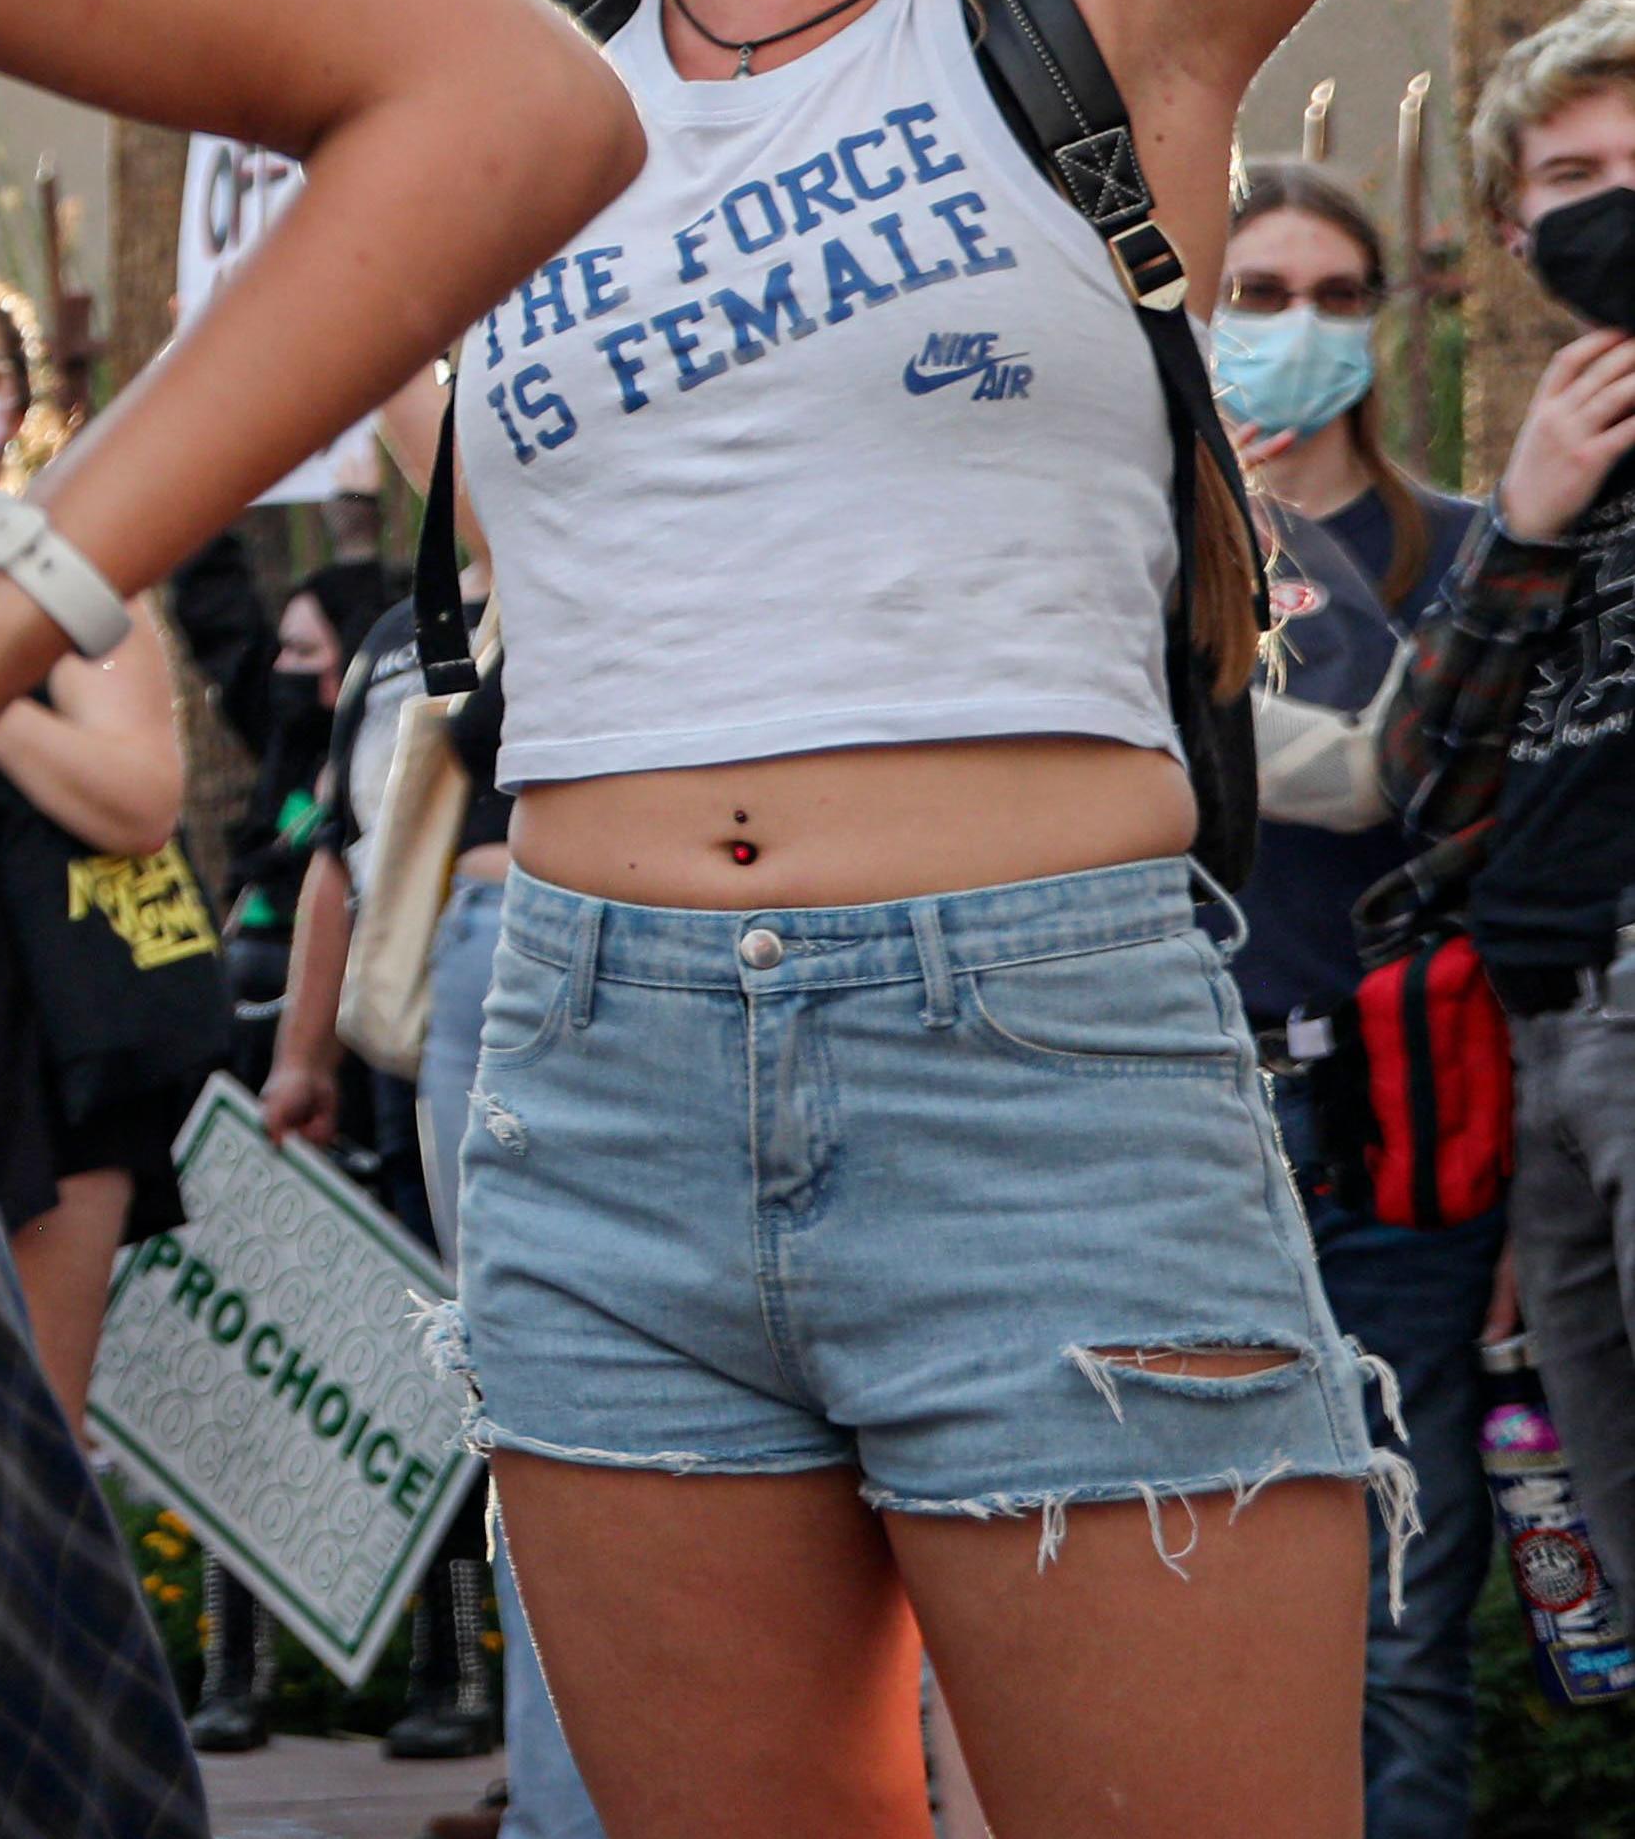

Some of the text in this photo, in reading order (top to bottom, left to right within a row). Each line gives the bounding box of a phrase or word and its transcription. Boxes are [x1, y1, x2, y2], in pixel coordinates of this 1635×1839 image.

[477, 100, 966, 371] THE FORCE
[486, 191, 1017, 466] IS FEMALE
[919, 332, 999, 367] NIKE
[971, 363, 1034, 401] AIR
[140, 1230, 437, 1521] PROCHOICE
